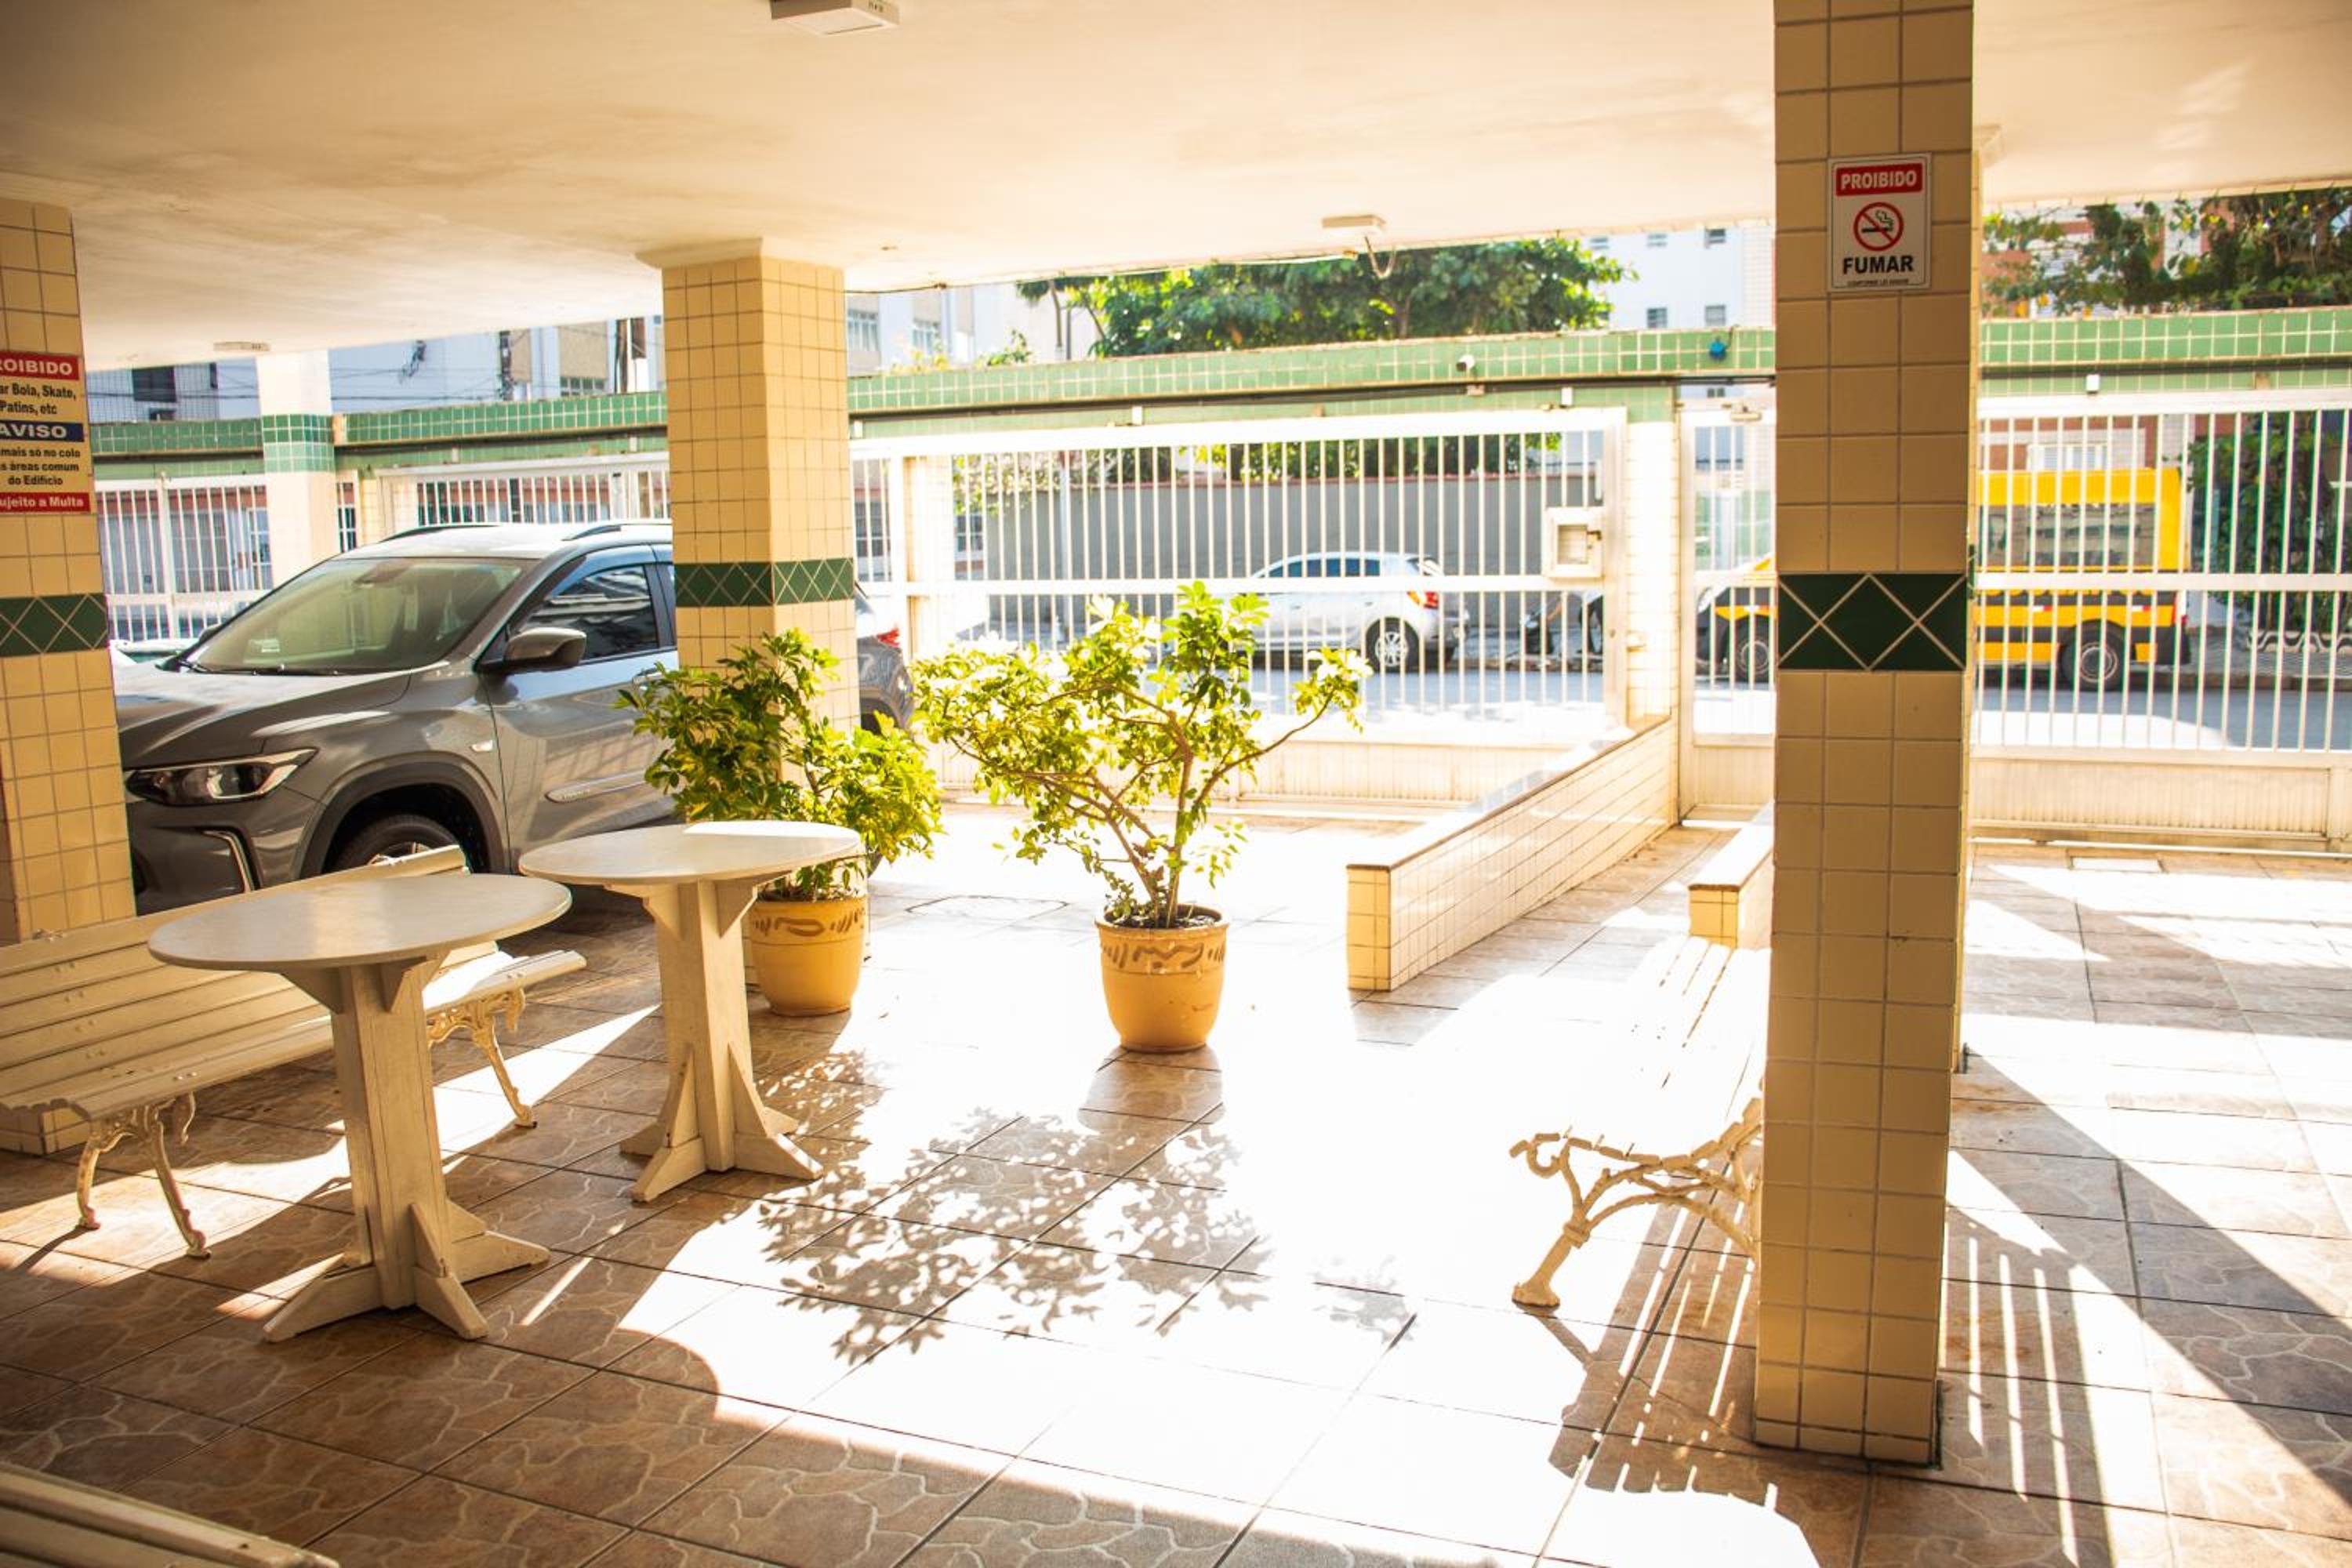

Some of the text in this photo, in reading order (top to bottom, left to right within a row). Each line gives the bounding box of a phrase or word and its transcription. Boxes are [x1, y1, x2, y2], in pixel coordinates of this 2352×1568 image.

[1841, 170, 1918, 190] PROIBIDO
[1842, 255, 1915, 274] FUMAR
[12, 382, 40, 398] Bola,
[42, 385, 77, 401] Skate,
[40, 403, 57, 415] etc
[0, 423, 67, 438] AVISO
[8, 475, 21, 485] do
[38, 498, 47, 506] a
[49, 495, 85, 507] Multa
